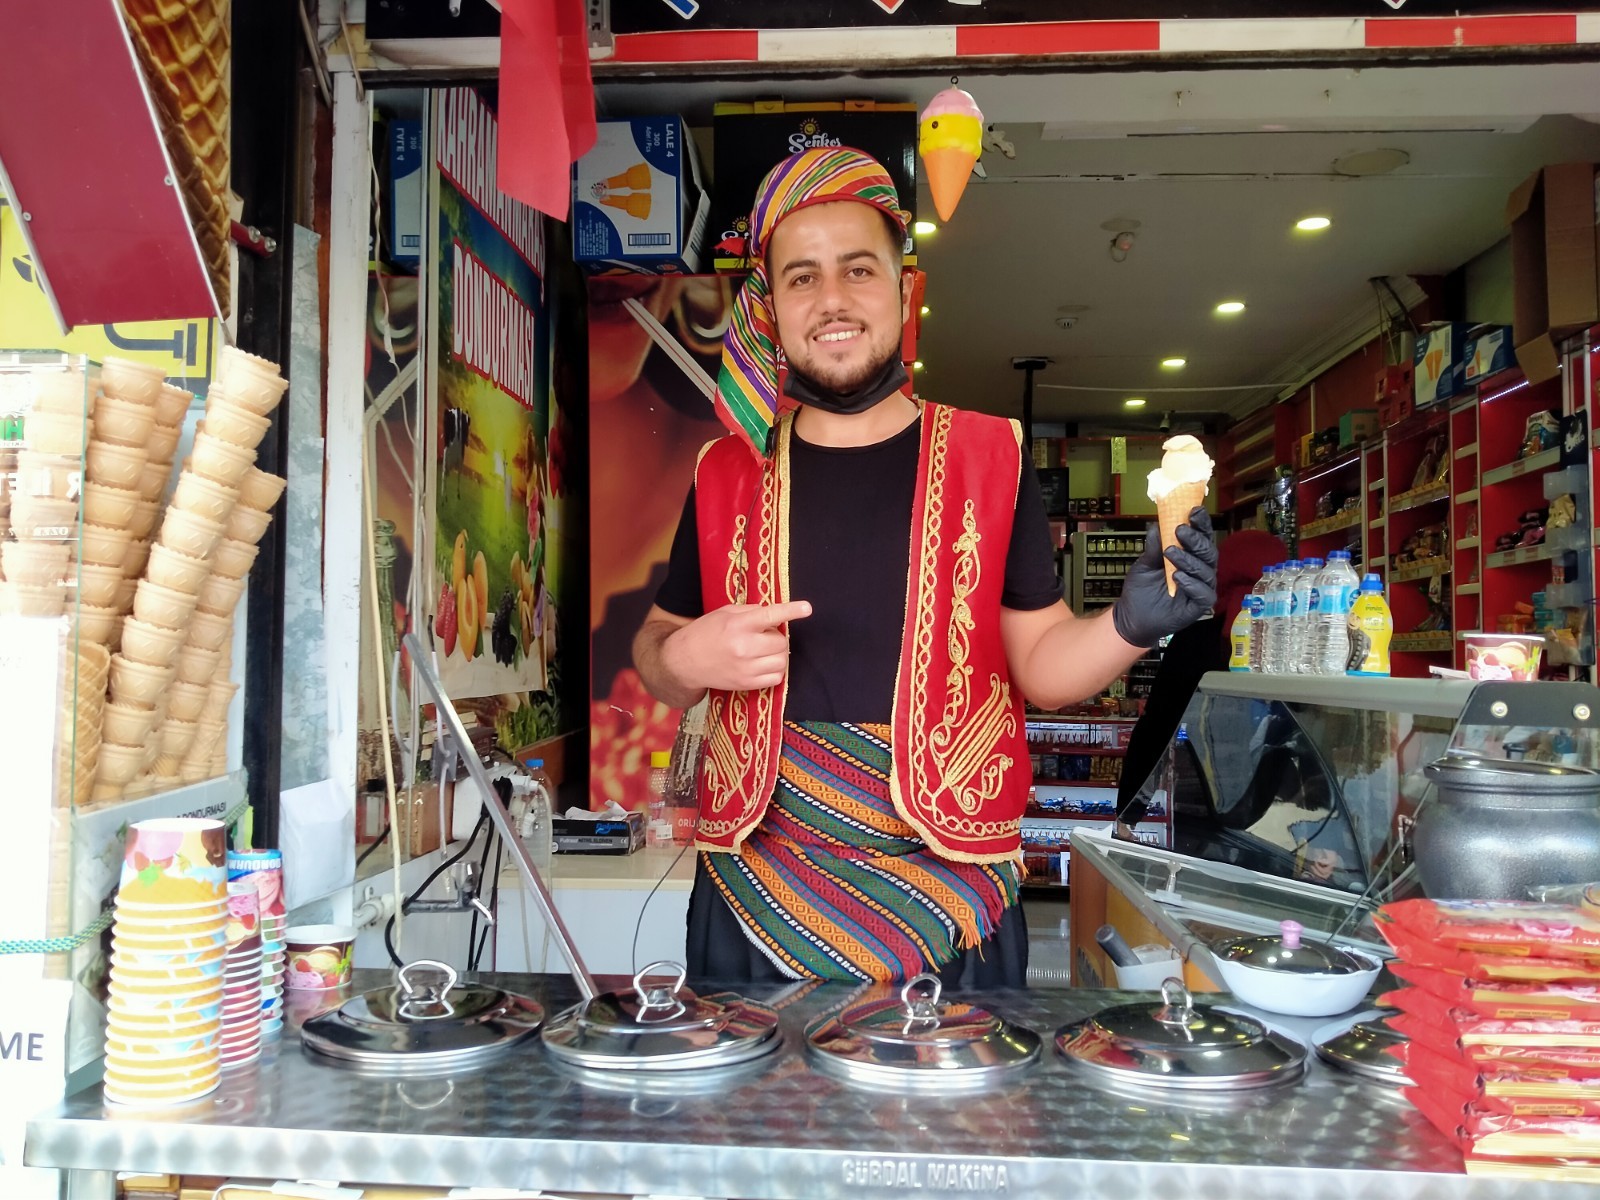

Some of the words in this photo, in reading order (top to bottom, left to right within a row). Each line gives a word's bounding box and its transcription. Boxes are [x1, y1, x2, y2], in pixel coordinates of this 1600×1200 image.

[666, 123, 675, 149] LALE
[666, 150, 675, 158] 4
[453, 243, 535, 407] DONDURMASI
